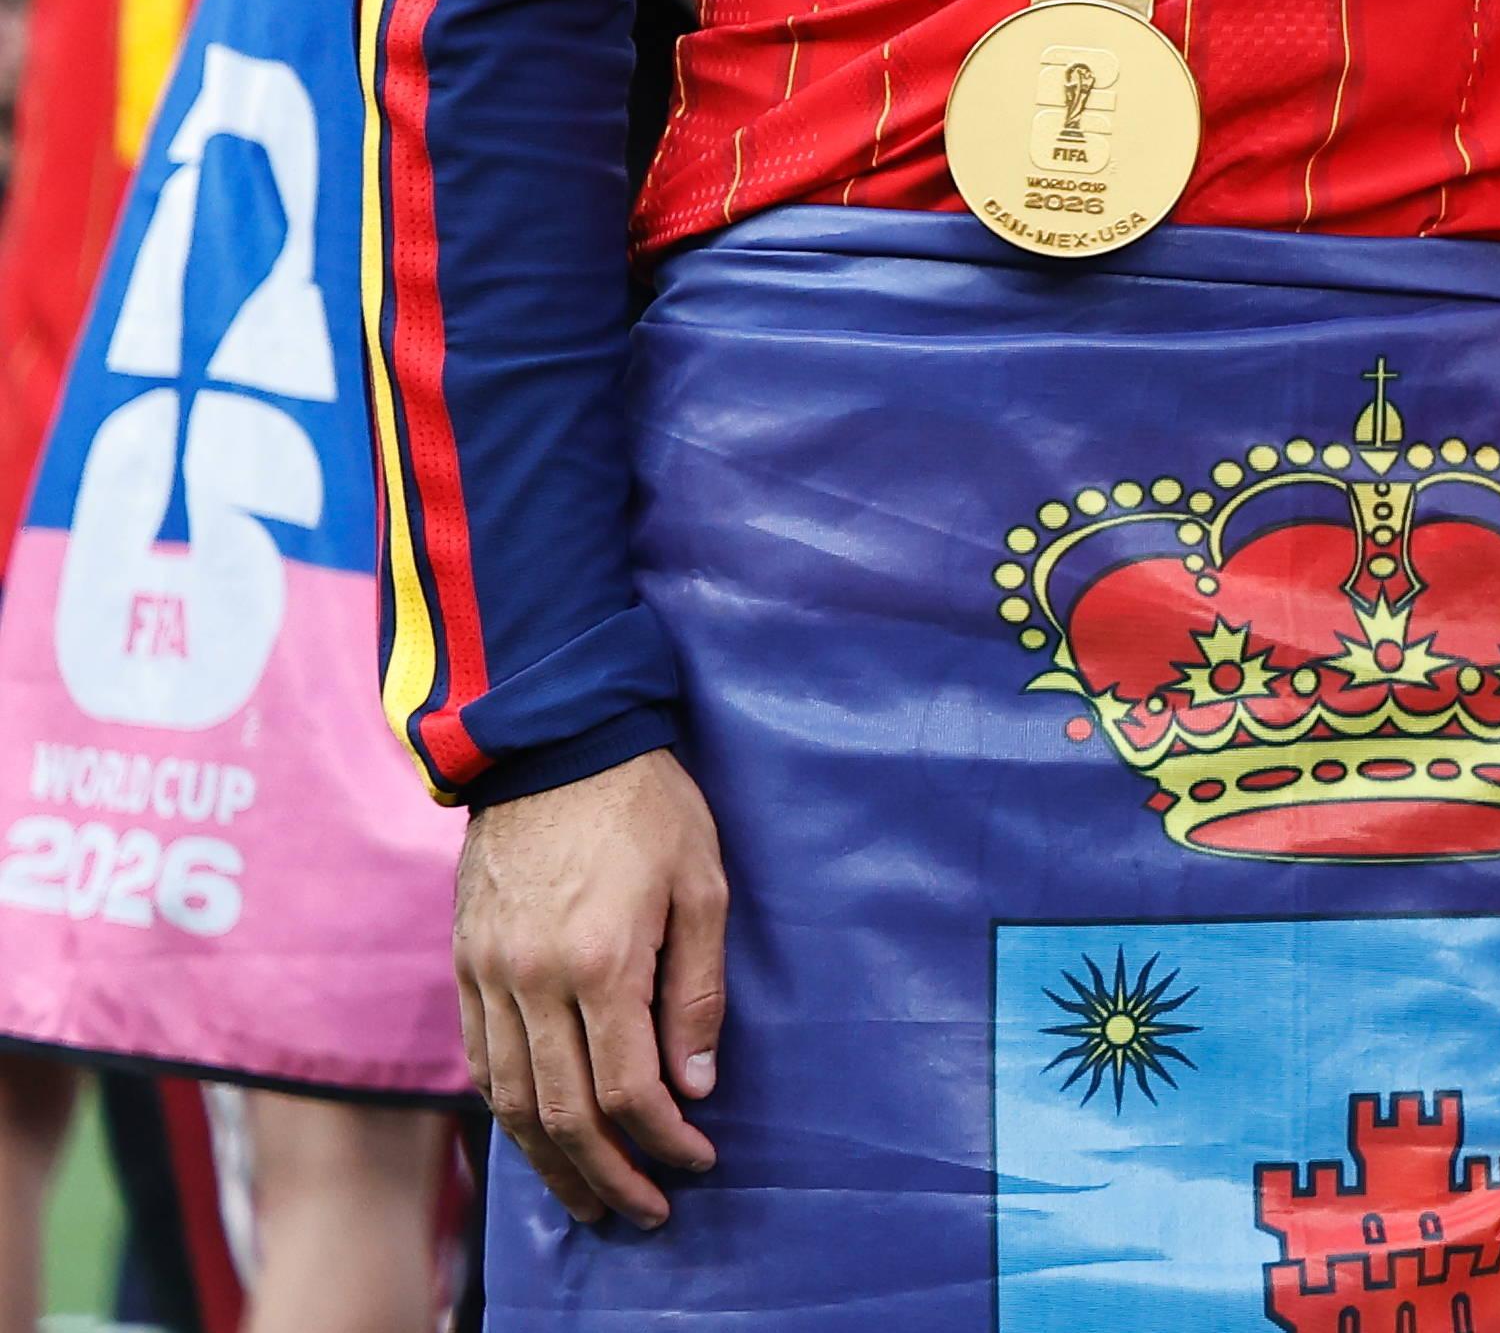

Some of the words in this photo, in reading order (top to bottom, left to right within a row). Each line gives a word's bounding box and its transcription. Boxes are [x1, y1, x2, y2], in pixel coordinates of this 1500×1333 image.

[1052, 147, 1088, 163] FIFA
[1026, 176, 1077, 191] WORLD
[1024, 191, 1105, 215] 2026
[151, 754, 257, 826] CUP
[0, 814, 246, 937] 2026
